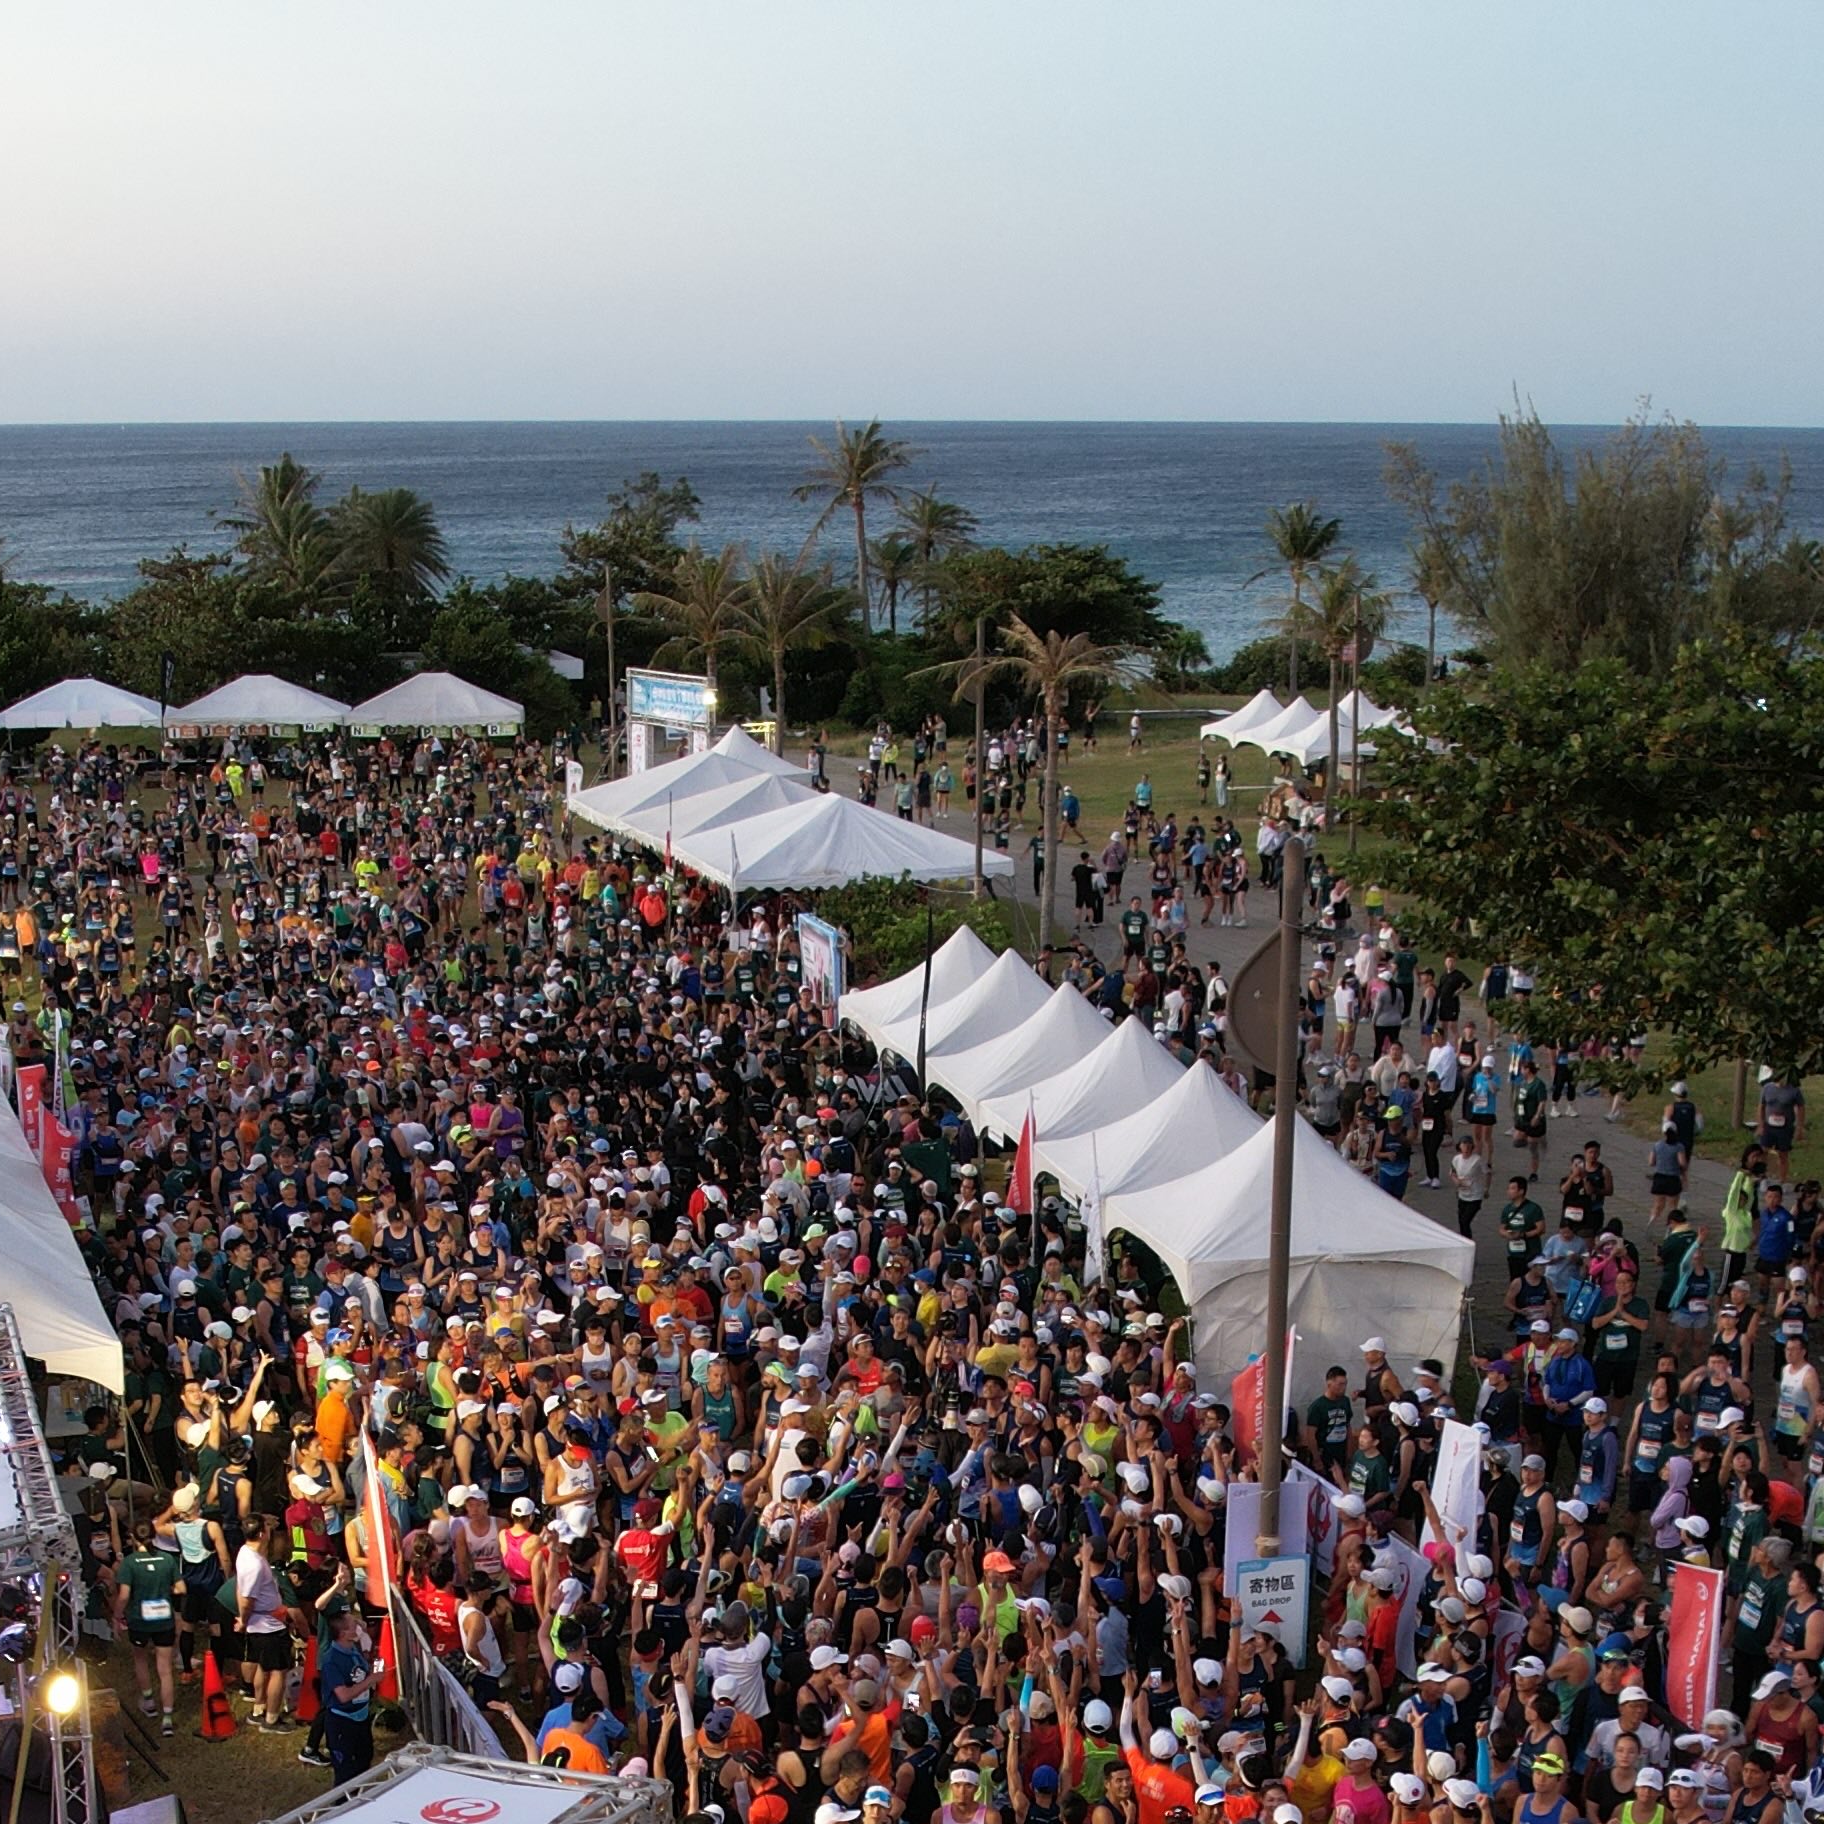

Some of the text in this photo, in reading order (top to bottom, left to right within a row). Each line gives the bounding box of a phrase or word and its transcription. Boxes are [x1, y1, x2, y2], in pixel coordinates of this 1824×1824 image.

[1249, 1575, 1296, 1594] 寄物區
[1251, 1597, 1292, 1608] BAG DROP
